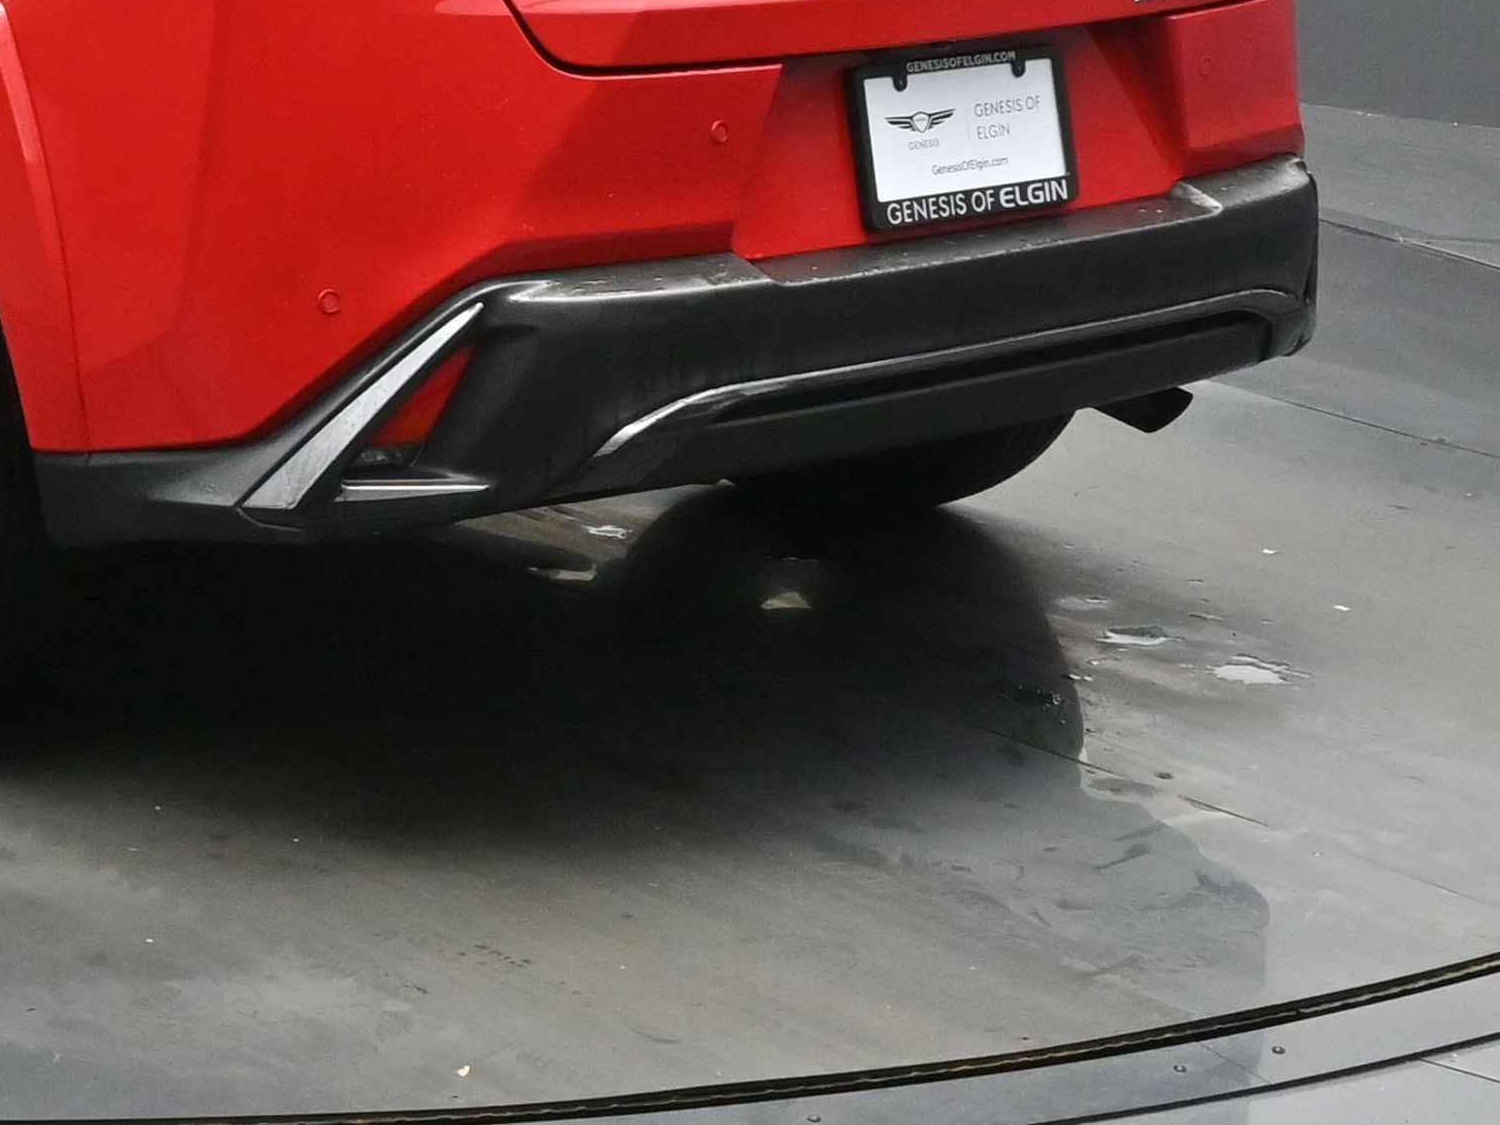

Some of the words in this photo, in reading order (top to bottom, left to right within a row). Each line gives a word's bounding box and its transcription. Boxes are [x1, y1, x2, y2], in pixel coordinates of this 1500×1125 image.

[906, 51, 1016, 73] GENESISOFELGIN.COM
[974, 97, 1023, 118] GENESIS
[1026, 95, 1041, 110] OF
[977, 123, 1010, 140] ELGIN
[908, 138, 940, 151] GENESIS
[886, 192, 967, 225] GENESIS
[971, 189, 995, 212] OF
[999, 178, 1069, 208] ELGIN
